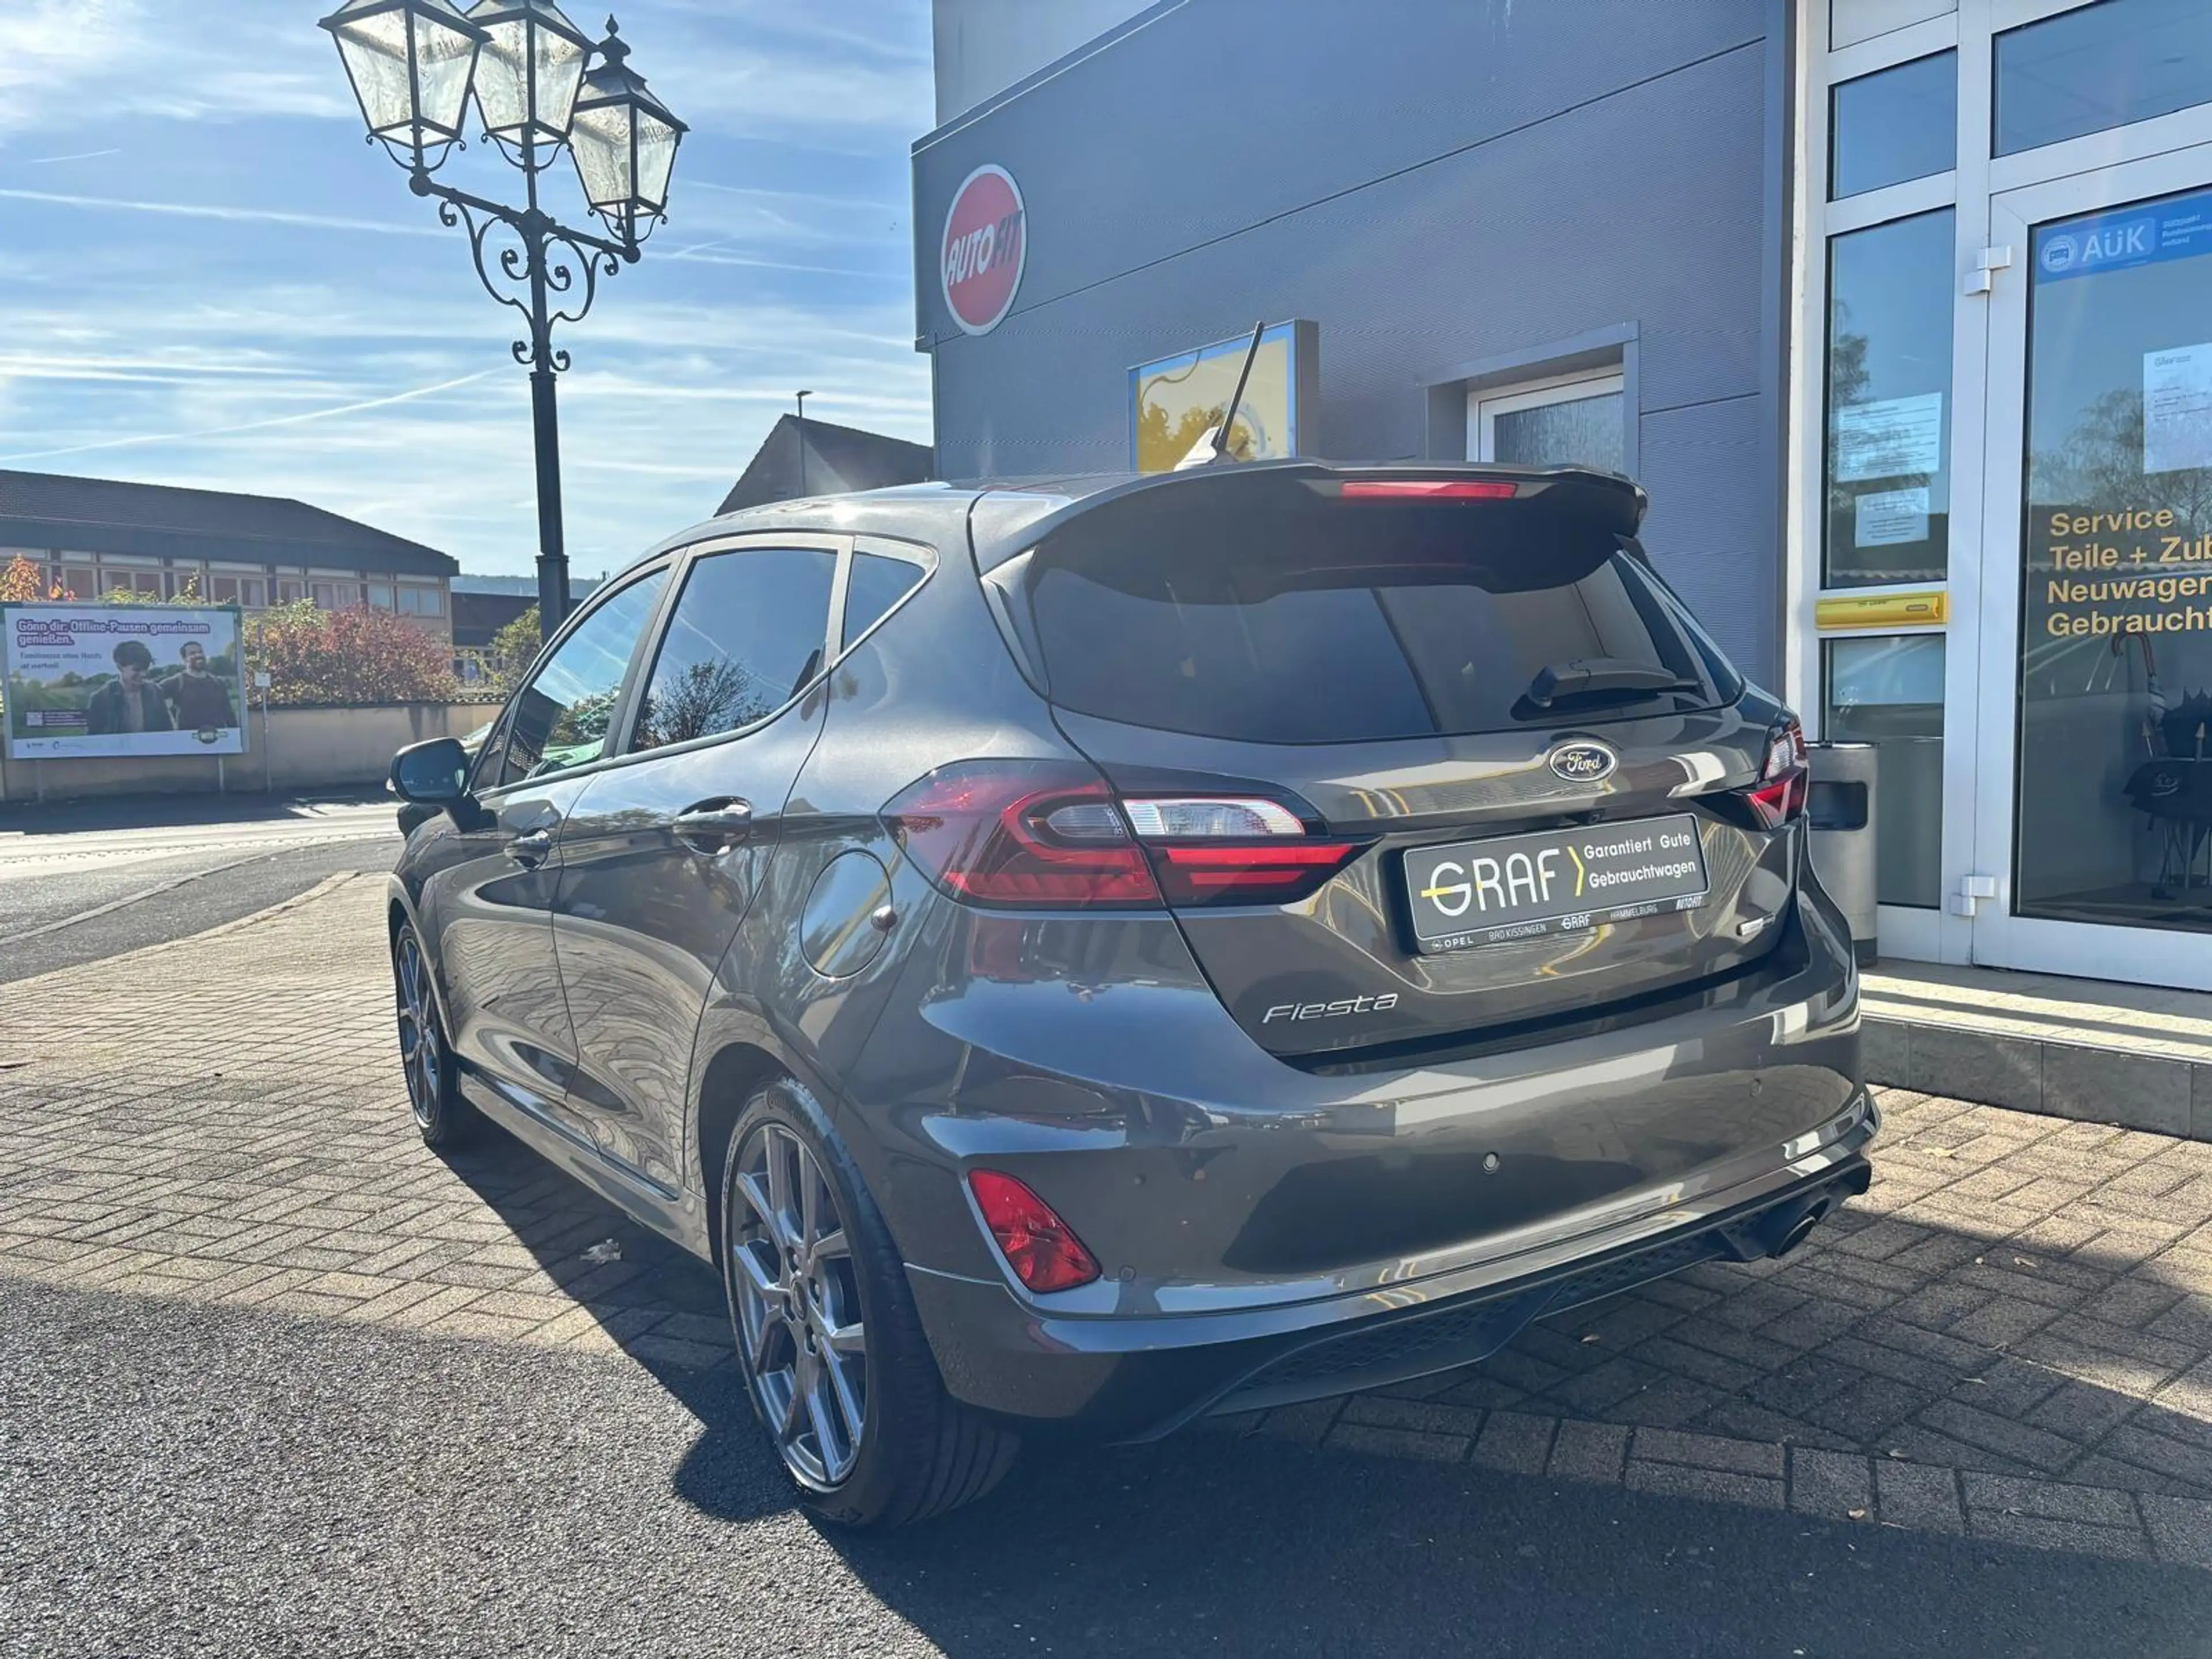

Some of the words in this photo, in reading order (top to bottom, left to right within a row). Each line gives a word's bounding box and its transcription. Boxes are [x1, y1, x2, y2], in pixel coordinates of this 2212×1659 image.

[946, 210, 1023, 286] AUTOFIT
[2082, 225, 2145, 262] AÜK
[2050, 504, 2174, 536] Service
[2049, 543, 2119, 571] Teile
[2130, 546, 2147, 566] +
[18, 619, 47, 632] Gönn
[70, 620, 147, 632] Offline-Pausen
[150, 622, 210, 634] gemeinsam
[18, 633, 74, 646] genießen.
[1566, 751, 1602, 772] Ford
[1421, 848, 1560, 916] GRAF
[1584, 838, 1653, 860] Garantiert
[1660, 832, 1691, 849] Gute
[1589, 859, 1696, 889] Gebrauchtwagen
[1444, 936, 1474, 948] OPEL
[1488, 929, 1506, 941] BAD
[1506, 923, 1547, 938] KISSINGEN
[1560, 914, 1591, 930] GRAF
[1610, 904, 1658, 921] HAMMELBURG
[1262, 993, 1399, 1024] Fiesta
